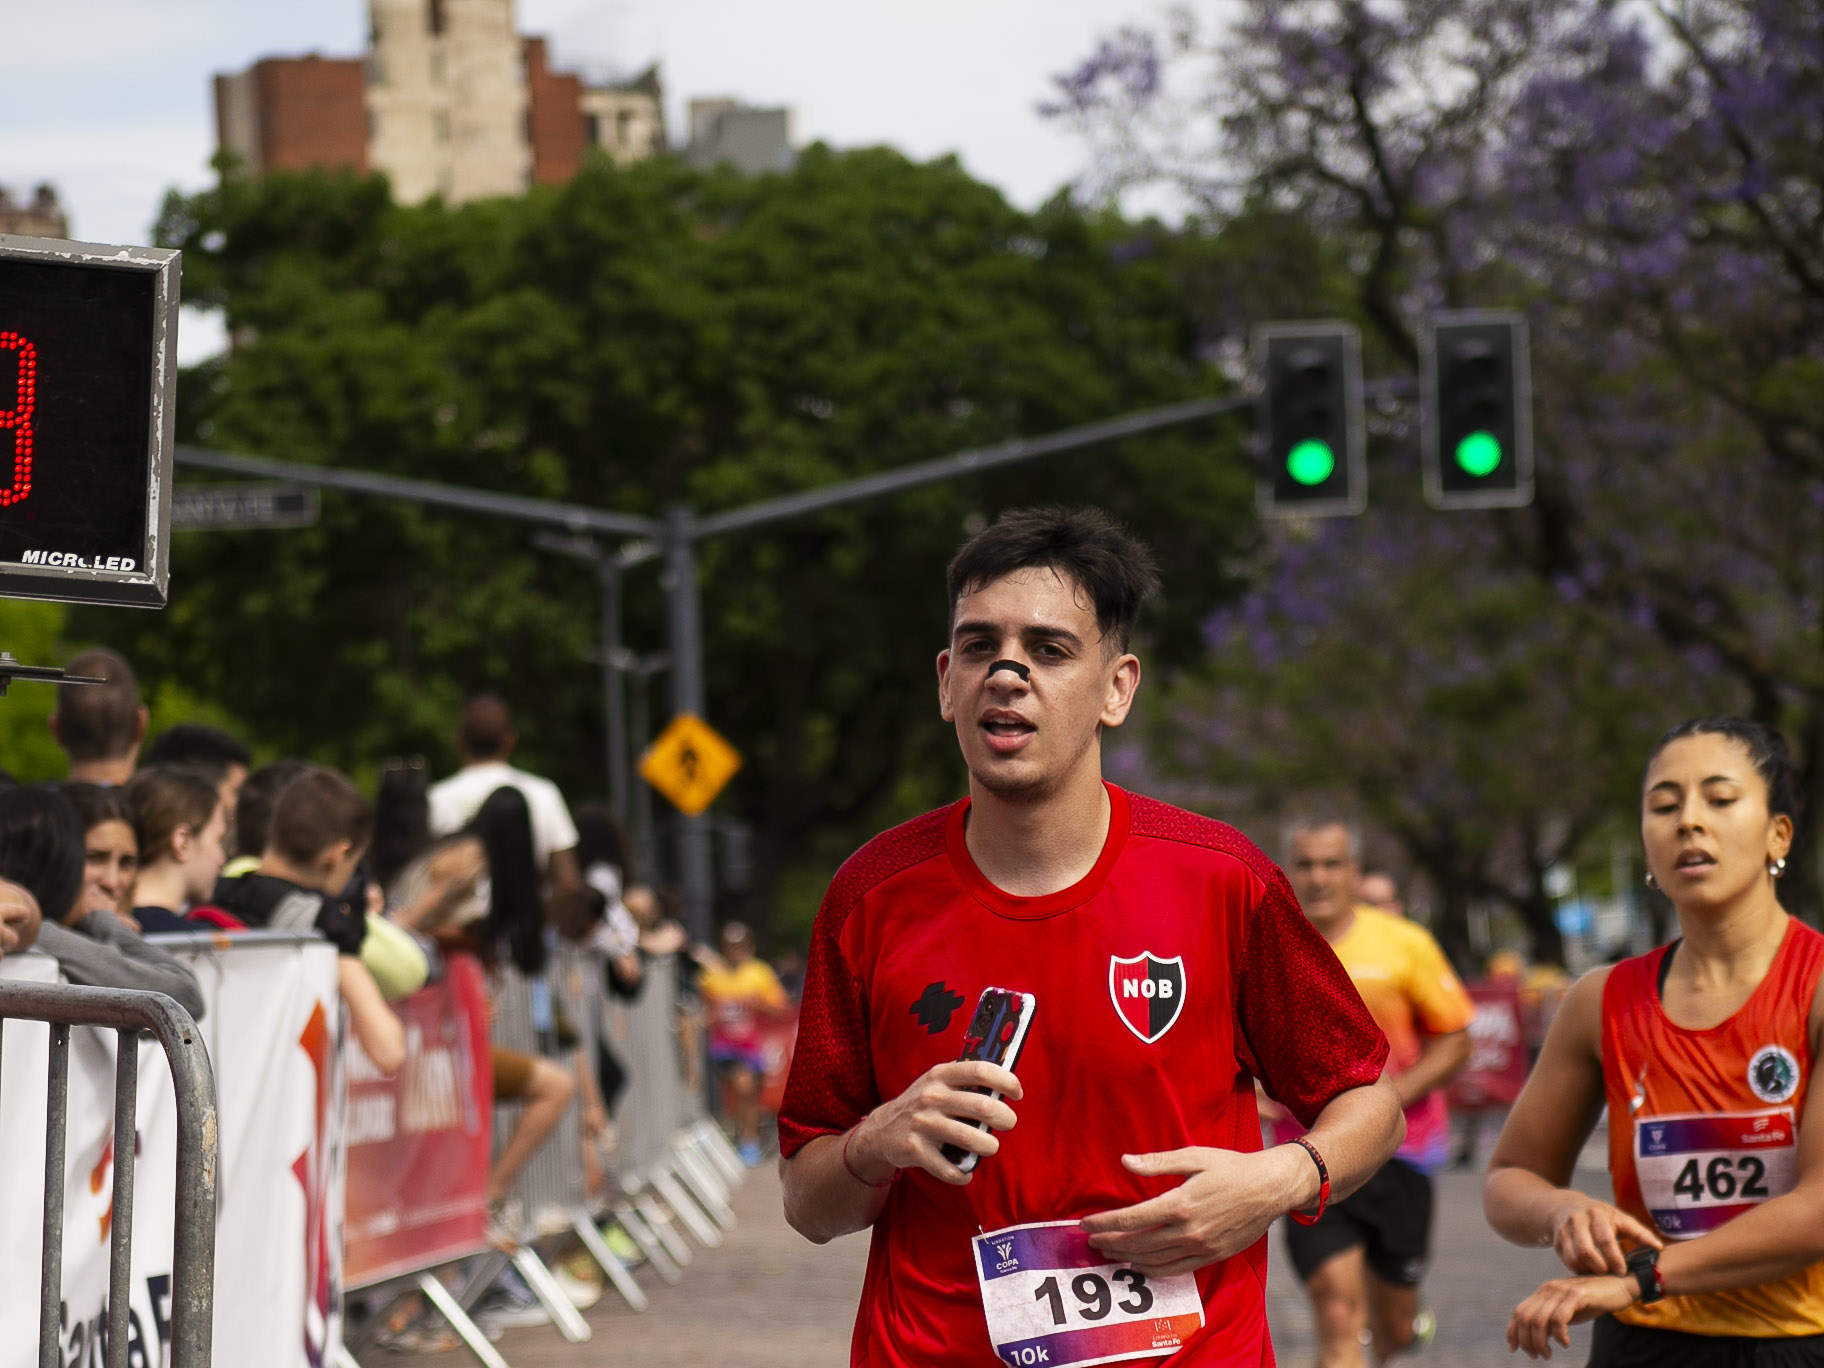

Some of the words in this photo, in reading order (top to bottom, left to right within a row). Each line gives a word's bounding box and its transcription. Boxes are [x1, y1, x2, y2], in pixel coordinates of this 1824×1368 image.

[1123, 978, 1174, 999] NOB
[1673, 1156, 1769, 1202] 462
[996, 1258, 1019, 1270] COPA
[1034, 1268, 1154, 1326] 193
[1151, 1339, 1173, 1348] Santa
[1010, 1345, 1050, 1366] 10k
